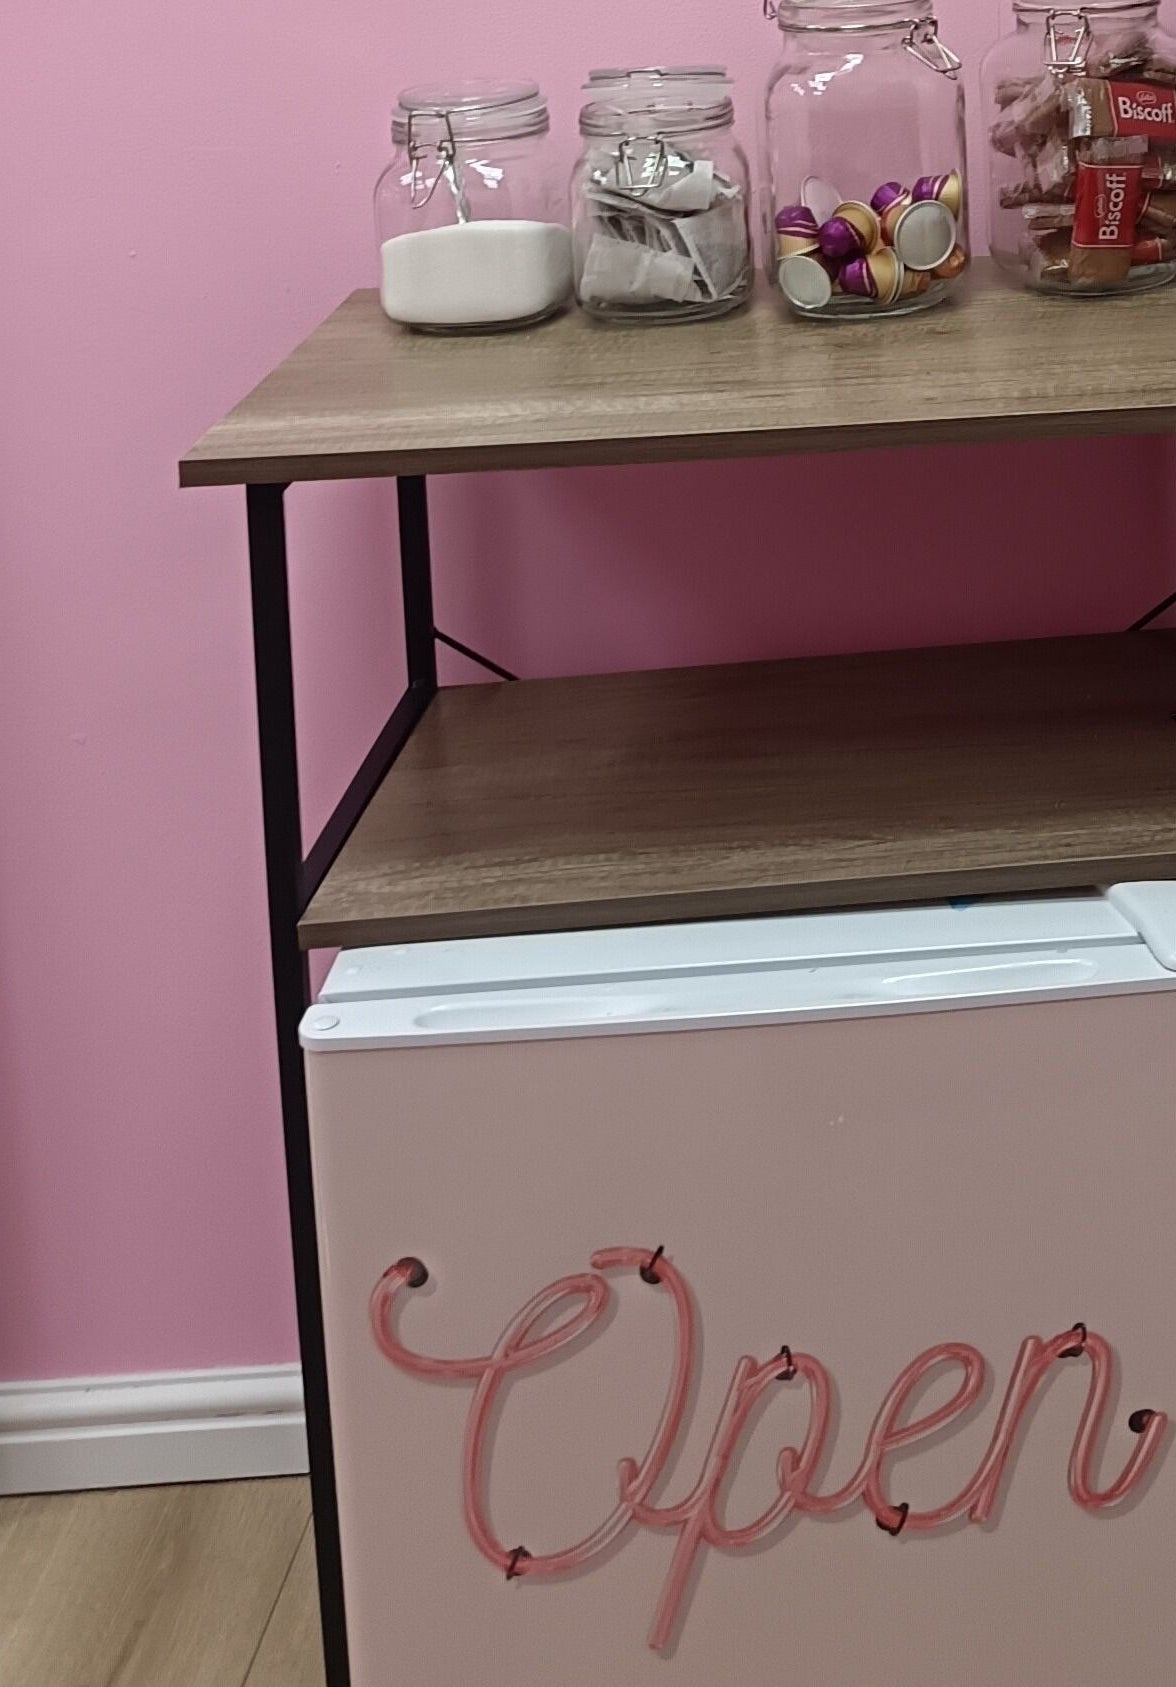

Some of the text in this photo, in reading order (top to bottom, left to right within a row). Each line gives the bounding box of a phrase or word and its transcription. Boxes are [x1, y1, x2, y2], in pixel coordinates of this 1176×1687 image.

[1118, 96, 1173, 123] Biscoff
[1099, 173, 1126, 239] Biscoff
[370, 1246, 1167, 1650] Open
